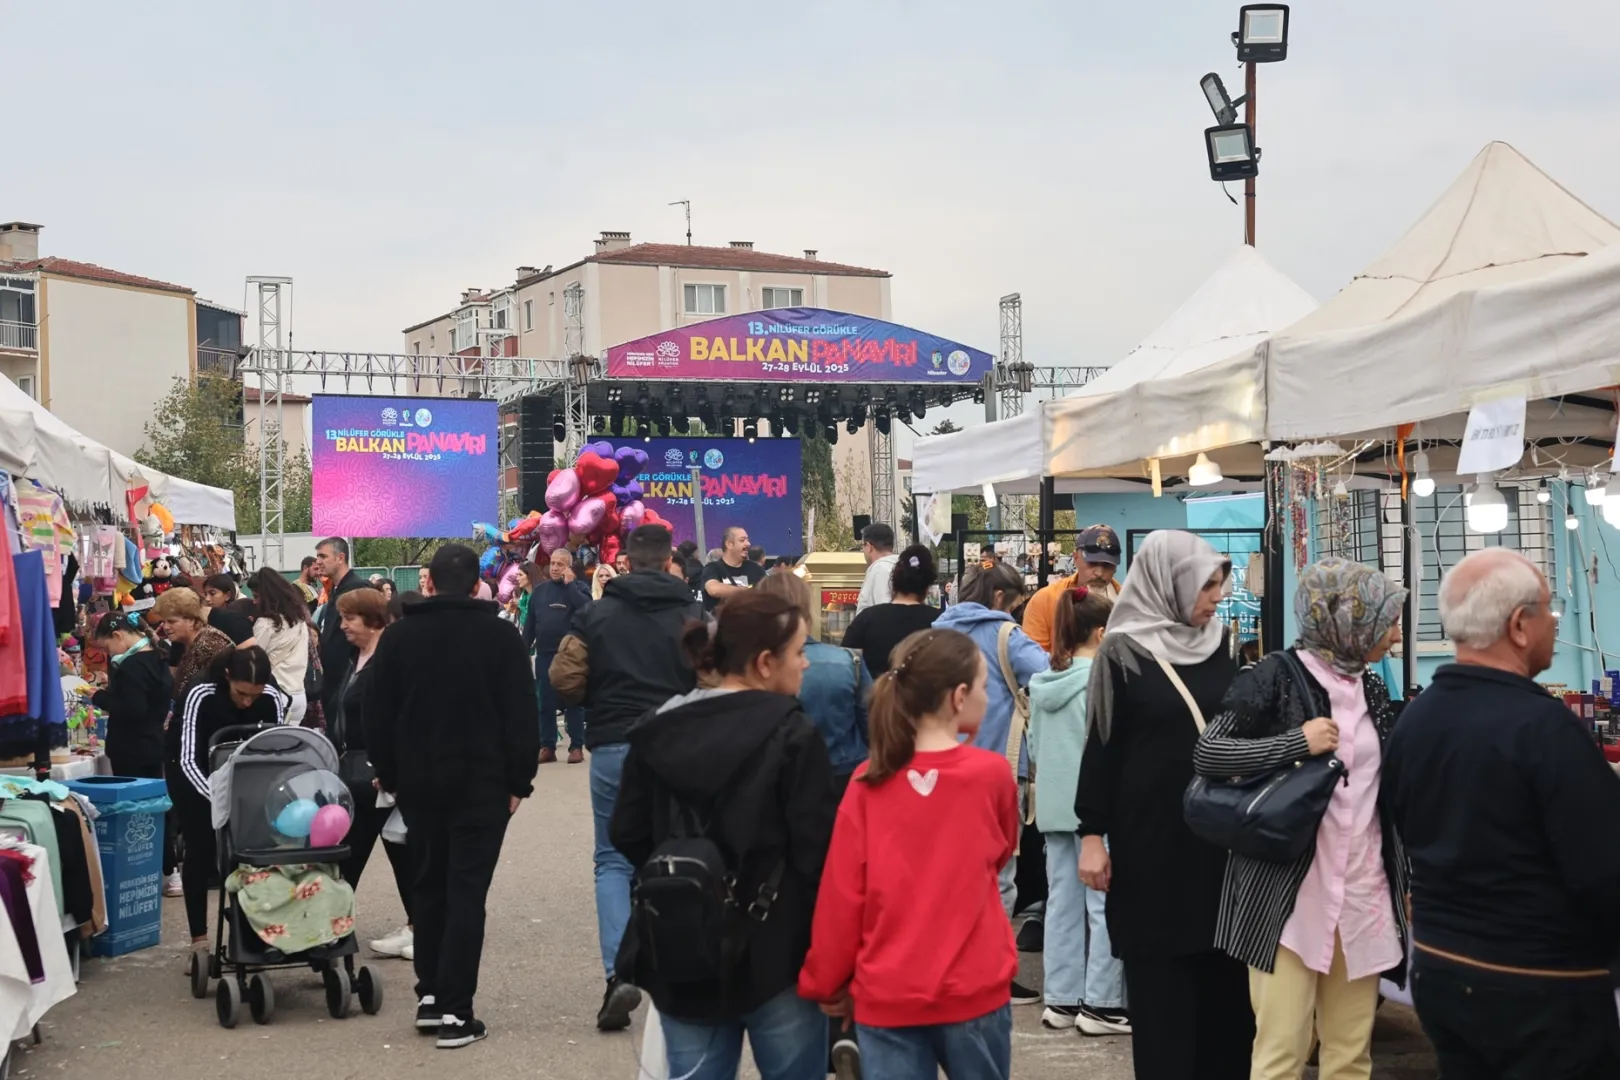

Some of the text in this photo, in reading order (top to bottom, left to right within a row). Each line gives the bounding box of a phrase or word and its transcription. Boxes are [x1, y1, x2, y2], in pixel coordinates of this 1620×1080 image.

[812, 325, 858, 335] GÖRÜKLE
[690, 336, 918, 367] BALKAN PANAYIRI
[761, 362, 849, 373] 27-28 EYLÜL 2025
[370, 429, 405, 438] GÖRÜKLE
[336, 431, 486, 455] BALKAN PANAYIRI
[424, 453, 441, 461] 2025
[652, 472, 692, 481] GÖRÜKLE
[119, 881, 159, 904] HEPİMİZİN
